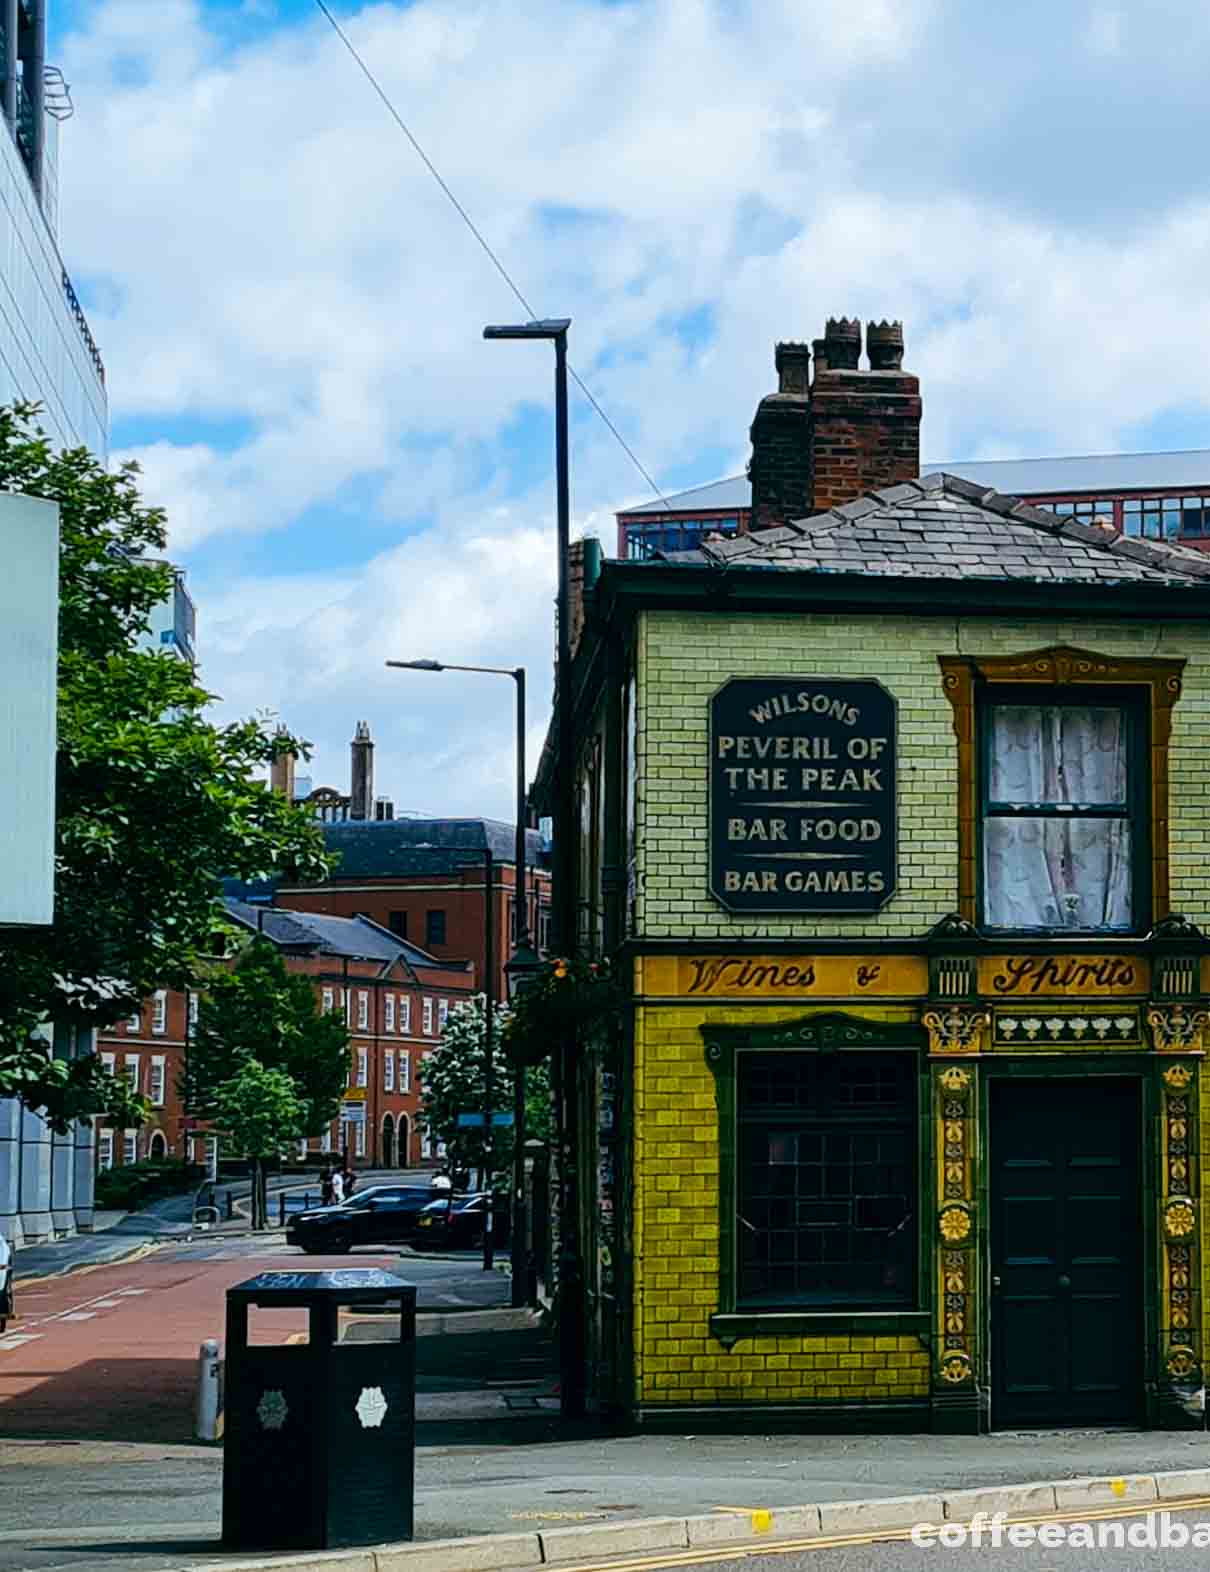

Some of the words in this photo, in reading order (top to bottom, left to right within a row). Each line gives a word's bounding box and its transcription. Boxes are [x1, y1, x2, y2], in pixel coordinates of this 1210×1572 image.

[750, 692, 860, 725] WILSONS
[718, 736, 838, 759] PEVERIL
[847, 737, 887, 760] OF
[724, 768, 789, 790] THE
[802, 768, 884, 791] PEAK
[727, 818, 789, 841] BAR
[800, 819, 881, 841] FOOD
[724, 871, 778, 892] BAR
[784, 871, 886, 893] GAMES
[688, 959, 816, 993] Wines
[856, 963, 881, 987] &
[993, 958, 1136, 993] Spirits
